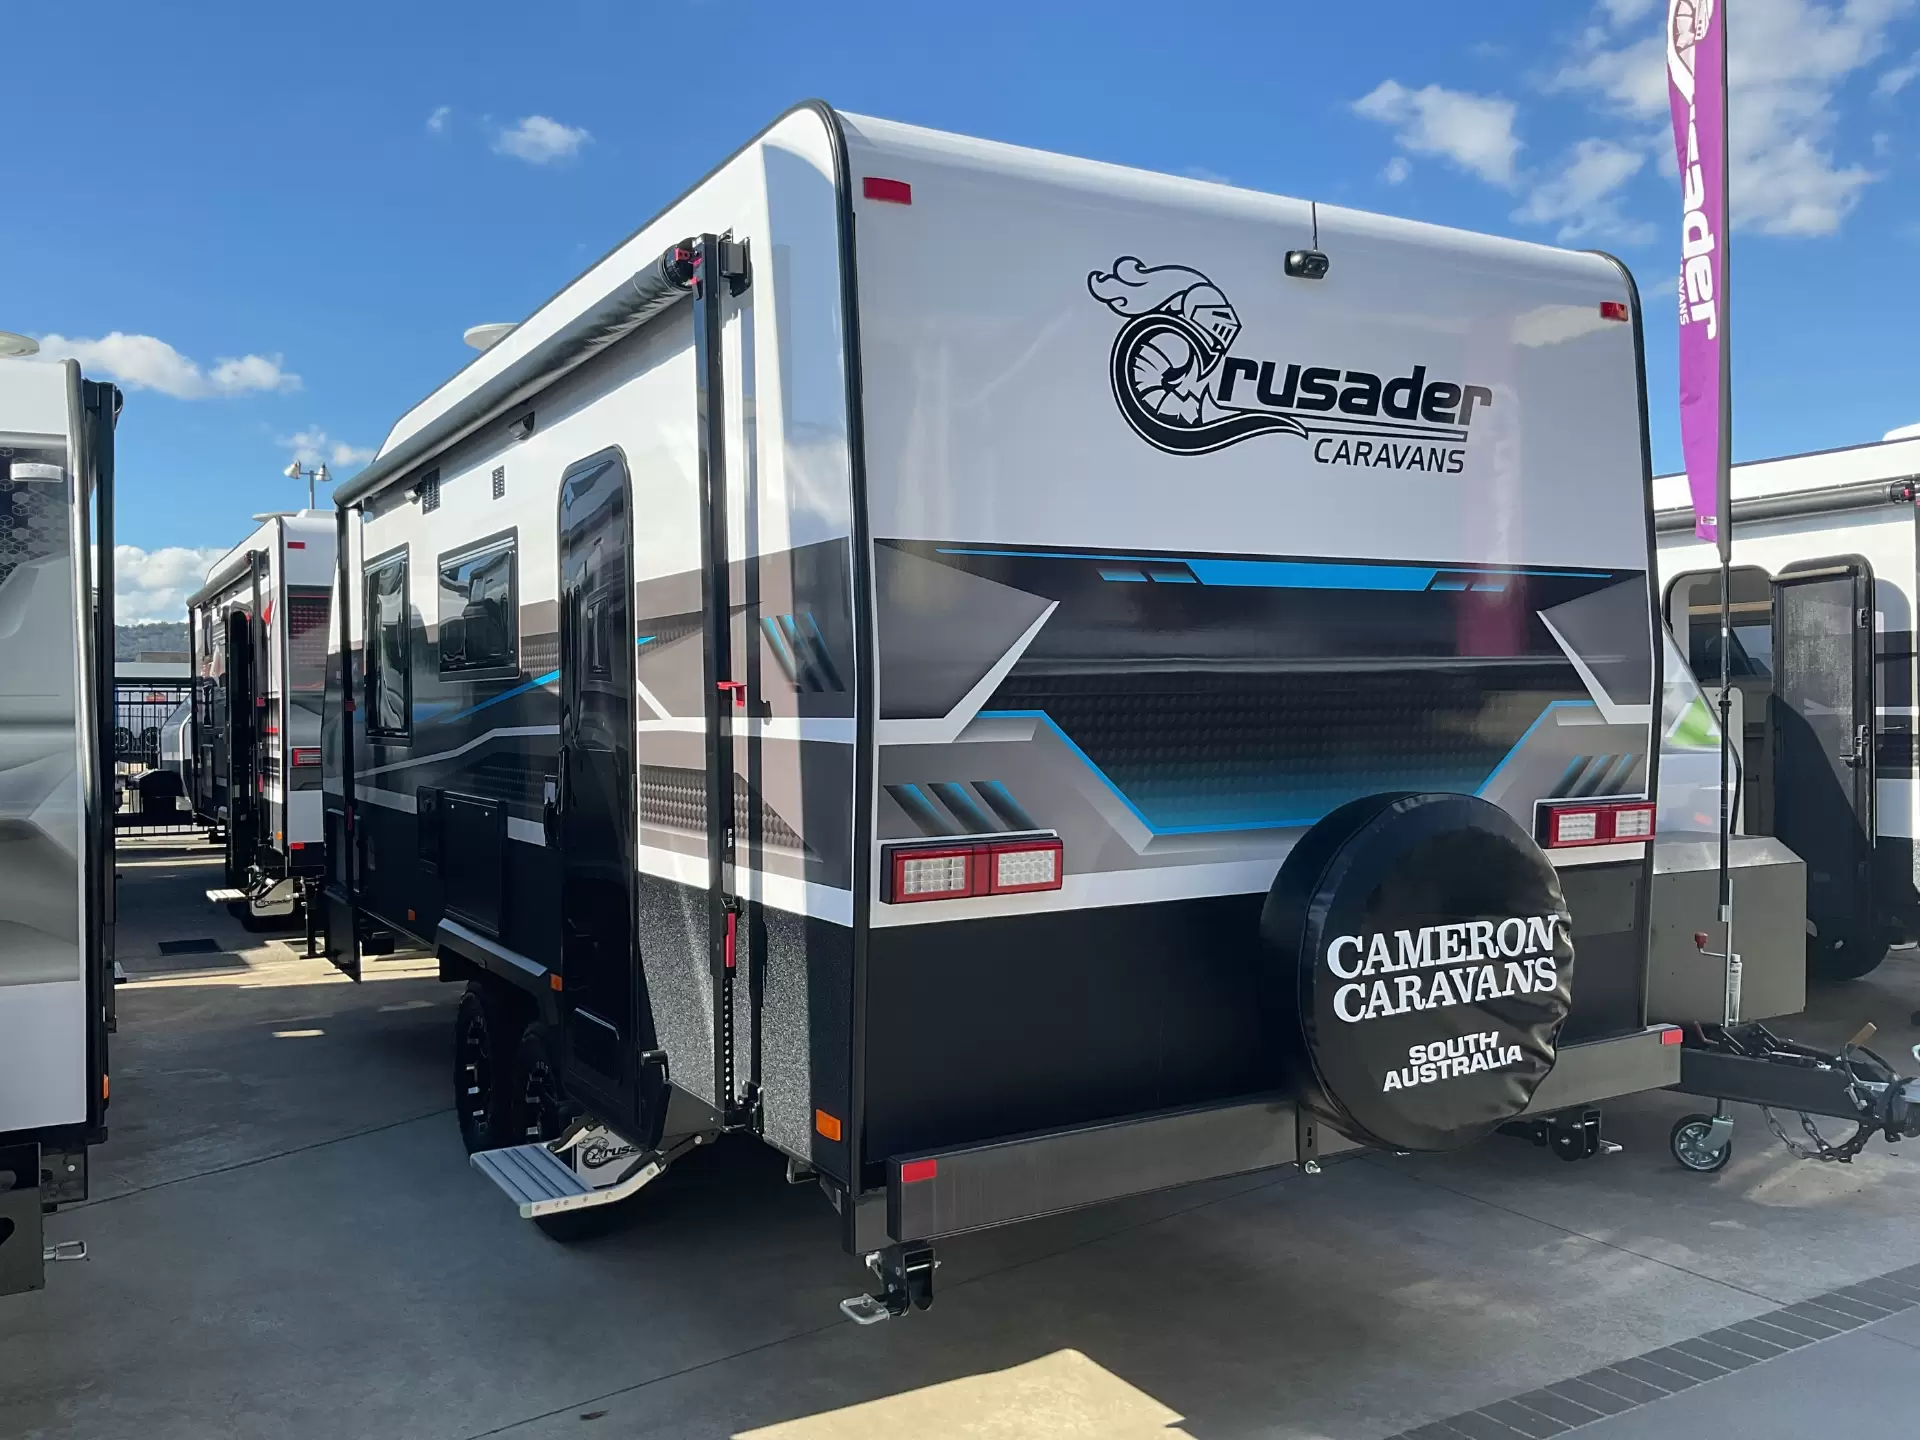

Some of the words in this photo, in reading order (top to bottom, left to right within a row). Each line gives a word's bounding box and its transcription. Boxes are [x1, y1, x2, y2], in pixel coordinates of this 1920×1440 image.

[1314, 438, 1465, 474] CARAVANS
[1326, 914, 1560, 979] CAMERON
[1333, 956, 1558, 1023] CARAVANS
[1383, 1045, 1523, 1092] AUSTRALIA
[1409, 1031, 1499, 1066] SOUTH
